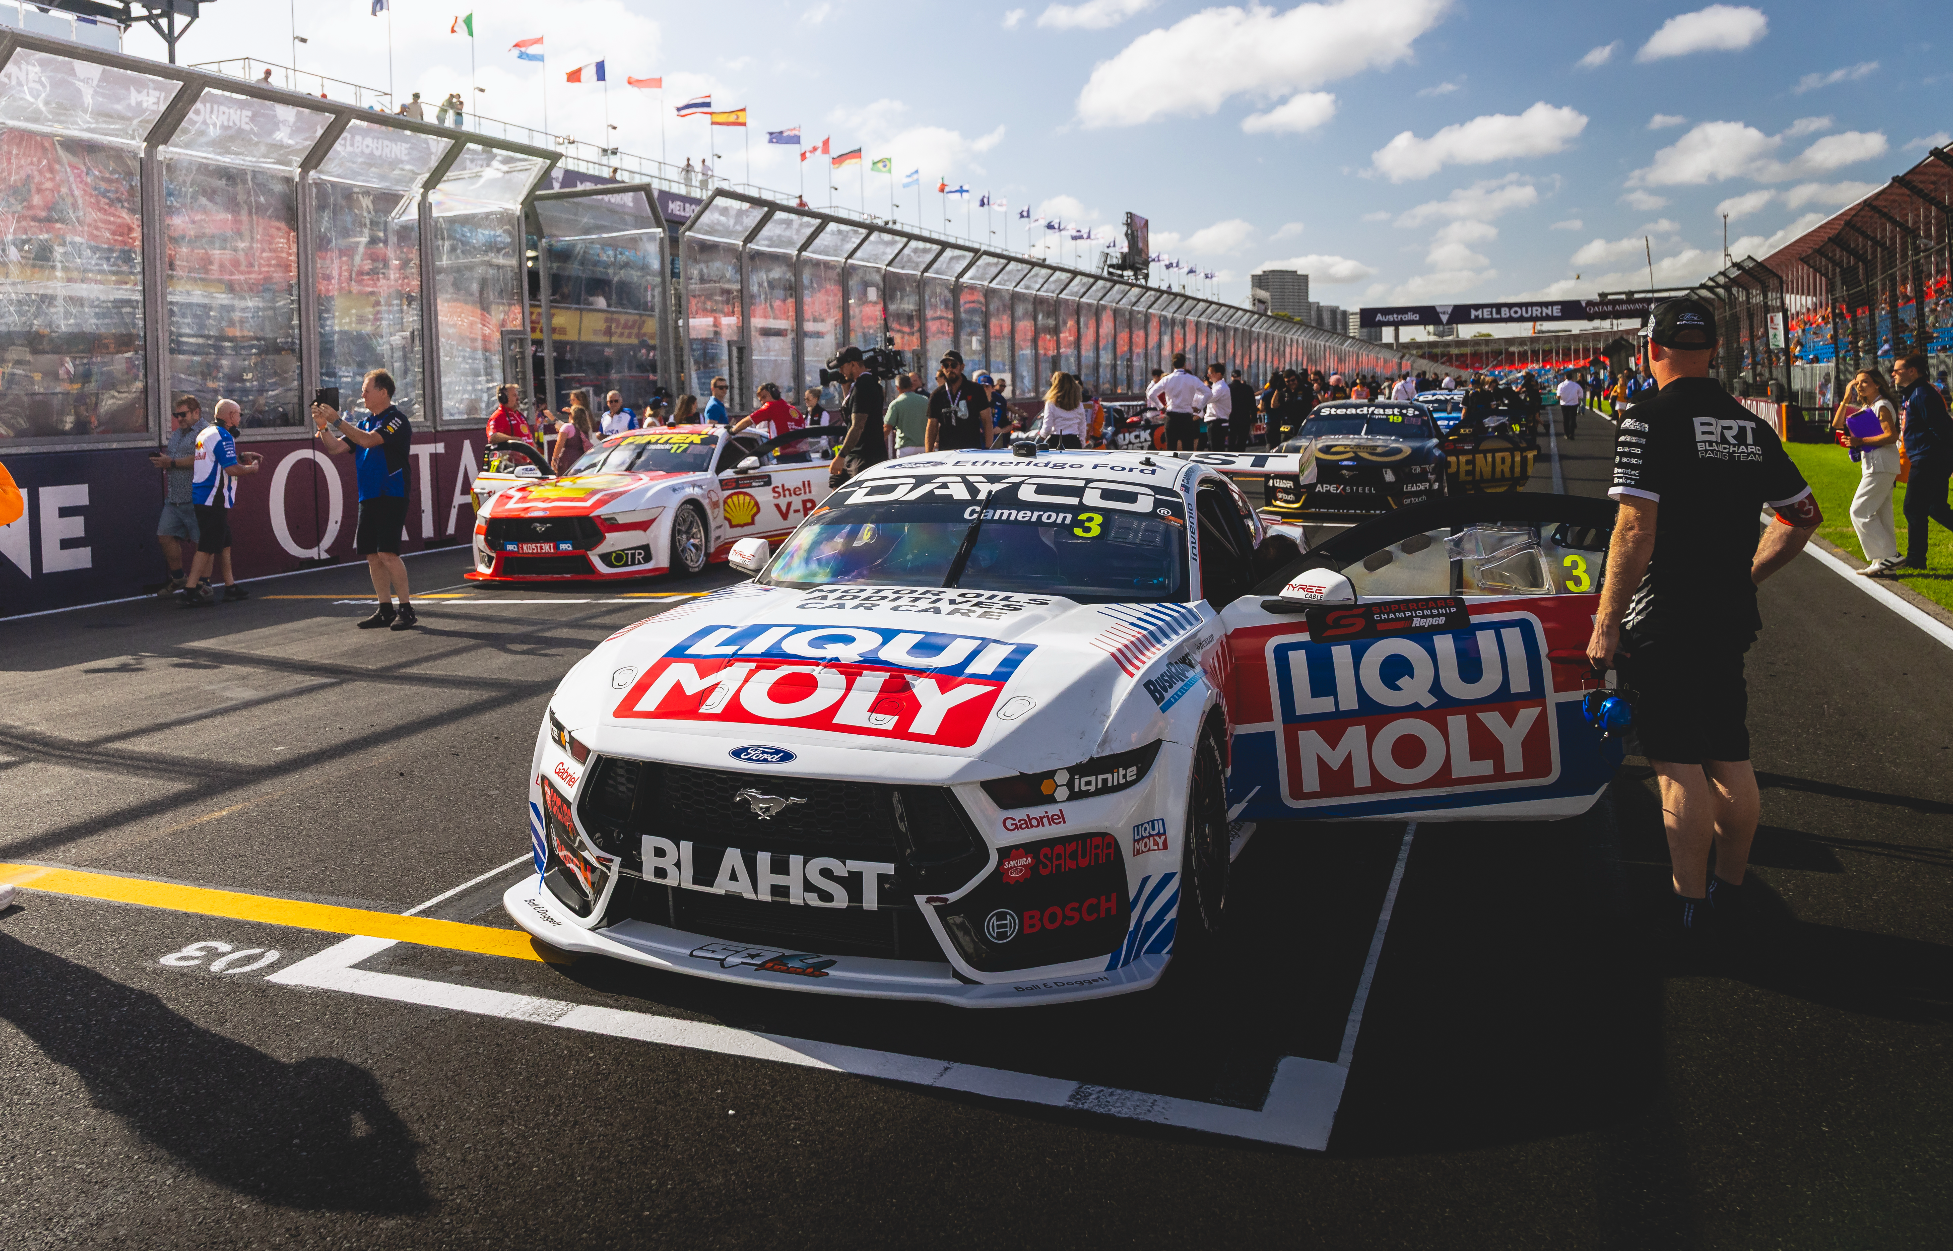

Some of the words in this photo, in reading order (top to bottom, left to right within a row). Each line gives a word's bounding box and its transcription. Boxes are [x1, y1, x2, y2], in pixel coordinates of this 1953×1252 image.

[1375, 311, 1420, 322] Australia
[1470, 305, 1562, 319] MELBOURNE
[1586, 304, 1613, 314] QATAR
[1614, 302, 1648, 311] AIRWAYS
[1320, 406, 1401, 416] Steadfast
[1388, 415, 1402, 423] 19
[1692, 416, 1757, 444] BRT
[620, 434, 709, 446] PIRTEK
[670, 444, 689, 453] 17
[1621, 457, 1643, 465] BOSCH
[1733, 453, 1763, 462] TEAM
[952, 459, 1084, 469] Etheridge
[1091, 463, 1157, 476] Ford
[771, 480, 812, 500] Shell
[843, 475, 1154, 513] DAYCO
[1315, 484, 1345, 495] APEX
[964, 505, 1073, 525] Cameron
[1073, 513, 1104, 538] 3
[611, 551, 645, 566] OTR
[1563, 554, 1592, 593] 3
[805, 588, 948, 597] MOTOR
[957, 592, 1052, 606] OILS
[1286, 583, 1327, 595] TYREE
[1304, 593, 1324, 601] CABLE
[796, 602, 881, 611] CAR
[889, 604, 1008, 620] CARE
[800, 594, 1024, 612] ADDITIVES
[1371, 599, 1455, 614] SUPERCARS
[1374, 607, 1458, 620] CHAMPIONSHIP
[1411, 616, 1446, 628] Repco
[685, 625, 1018, 676] LIQUI
[1288, 627, 1531, 716] LIQUI
[633, 662, 998, 737] MOLY
[741, 745, 783, 763] Ford
[1297, 706, 1542, 793] MOLY
[554, 761, 580, 788] Gabriel
[1074, 765, 1138, 793] ignite
[1002, 809, 1066, 832] Gabriel
[1133, 819, 1164, 841] LIQUI
[1134, 834, 1167, 856] MOLY
[1003, 856, 1032, 869] SAKURA
[1039, 834, 1116, 876] SAKURA
[641, 834, 895, 911] BLAHST
[1023, 892, 1117, 934] BOSCH
[1013, 984, 1042, 992] Ball
[1053, 976, 1110, 987] Doggett
